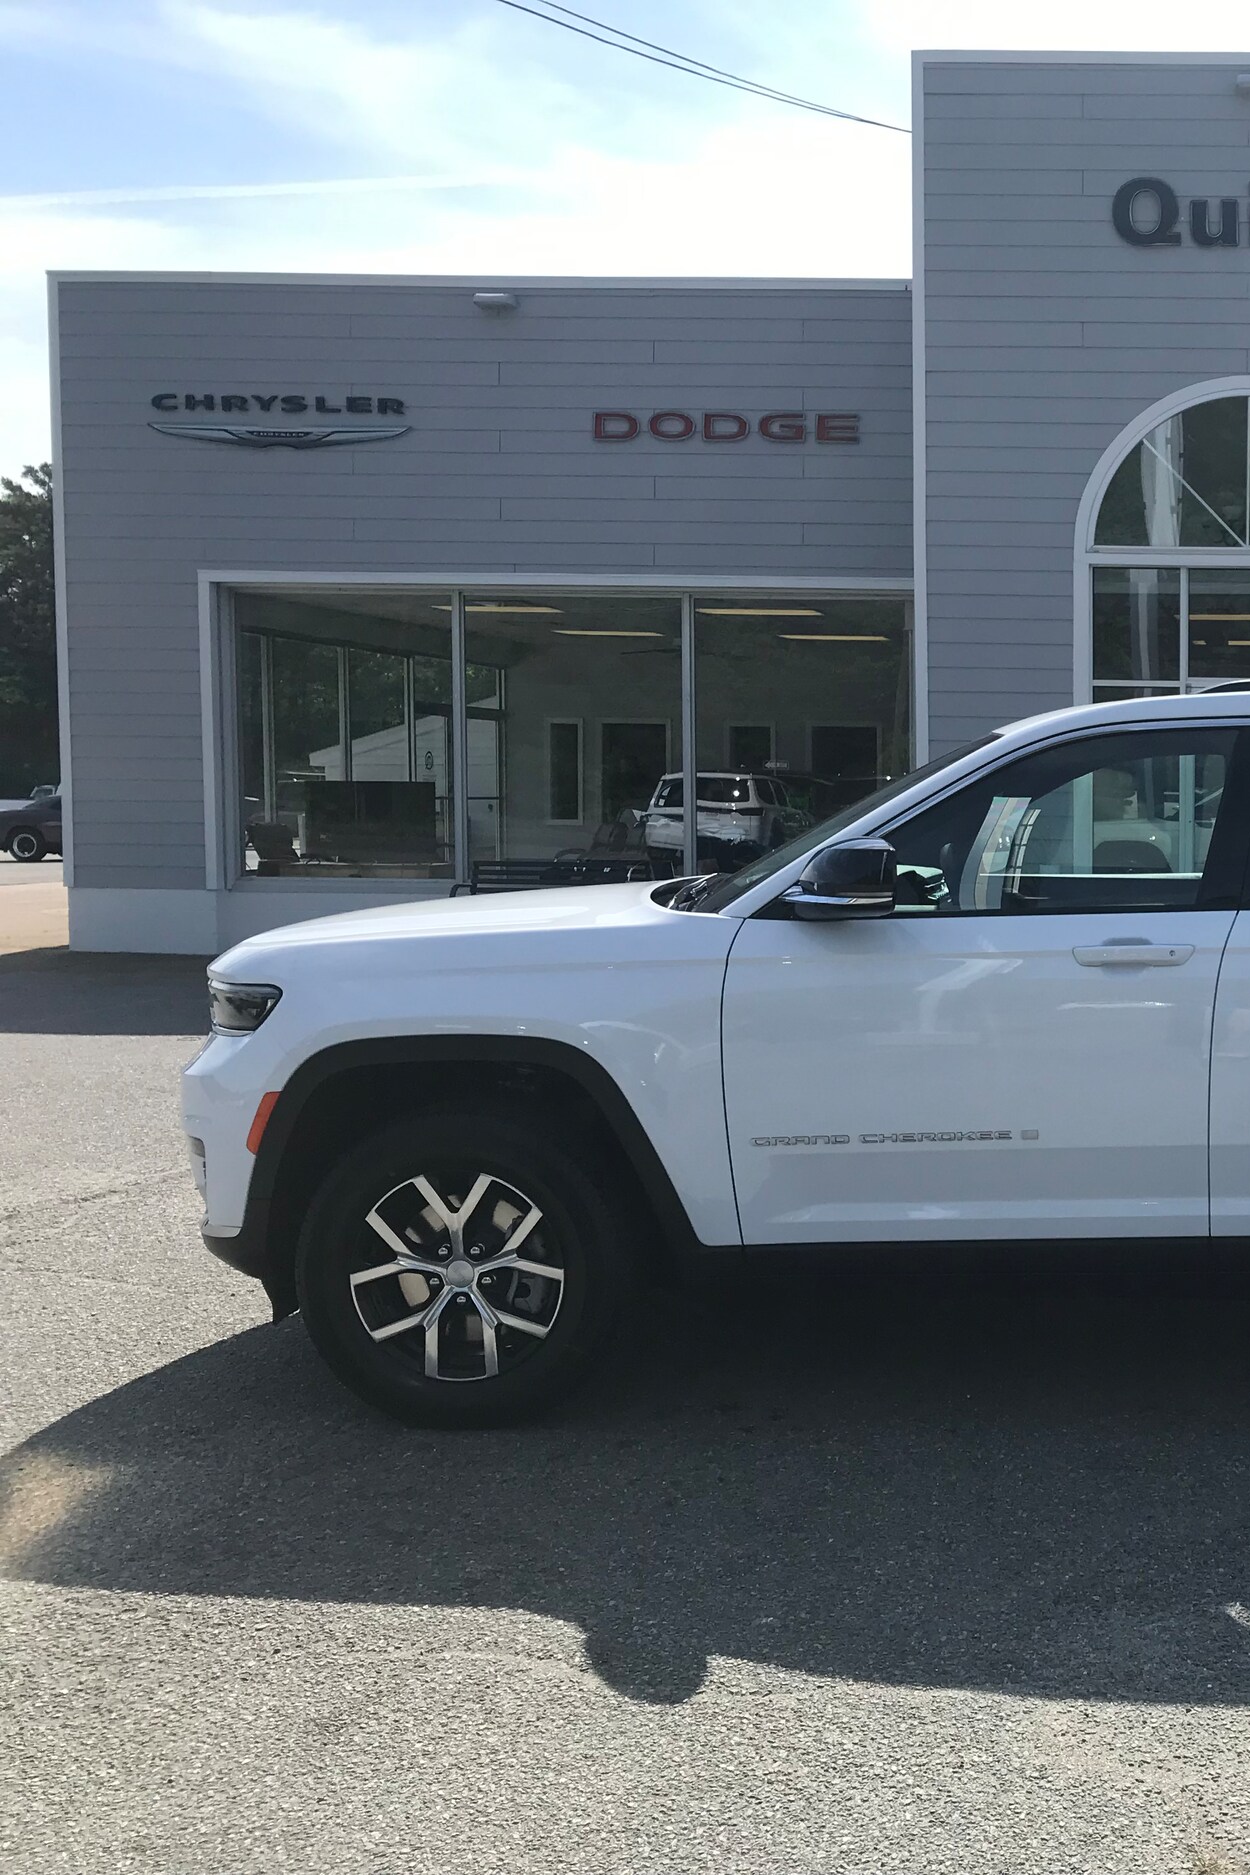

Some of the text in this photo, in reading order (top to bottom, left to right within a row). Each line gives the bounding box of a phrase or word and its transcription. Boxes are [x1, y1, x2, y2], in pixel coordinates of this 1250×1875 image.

[151, 393, 405, 415] CHRYSLER
[592, 411, 860, 443] DODGE
[750, 1134, 850, 1146] GRAND
[858, 1130, 1013, 1144] CHEROKEE
